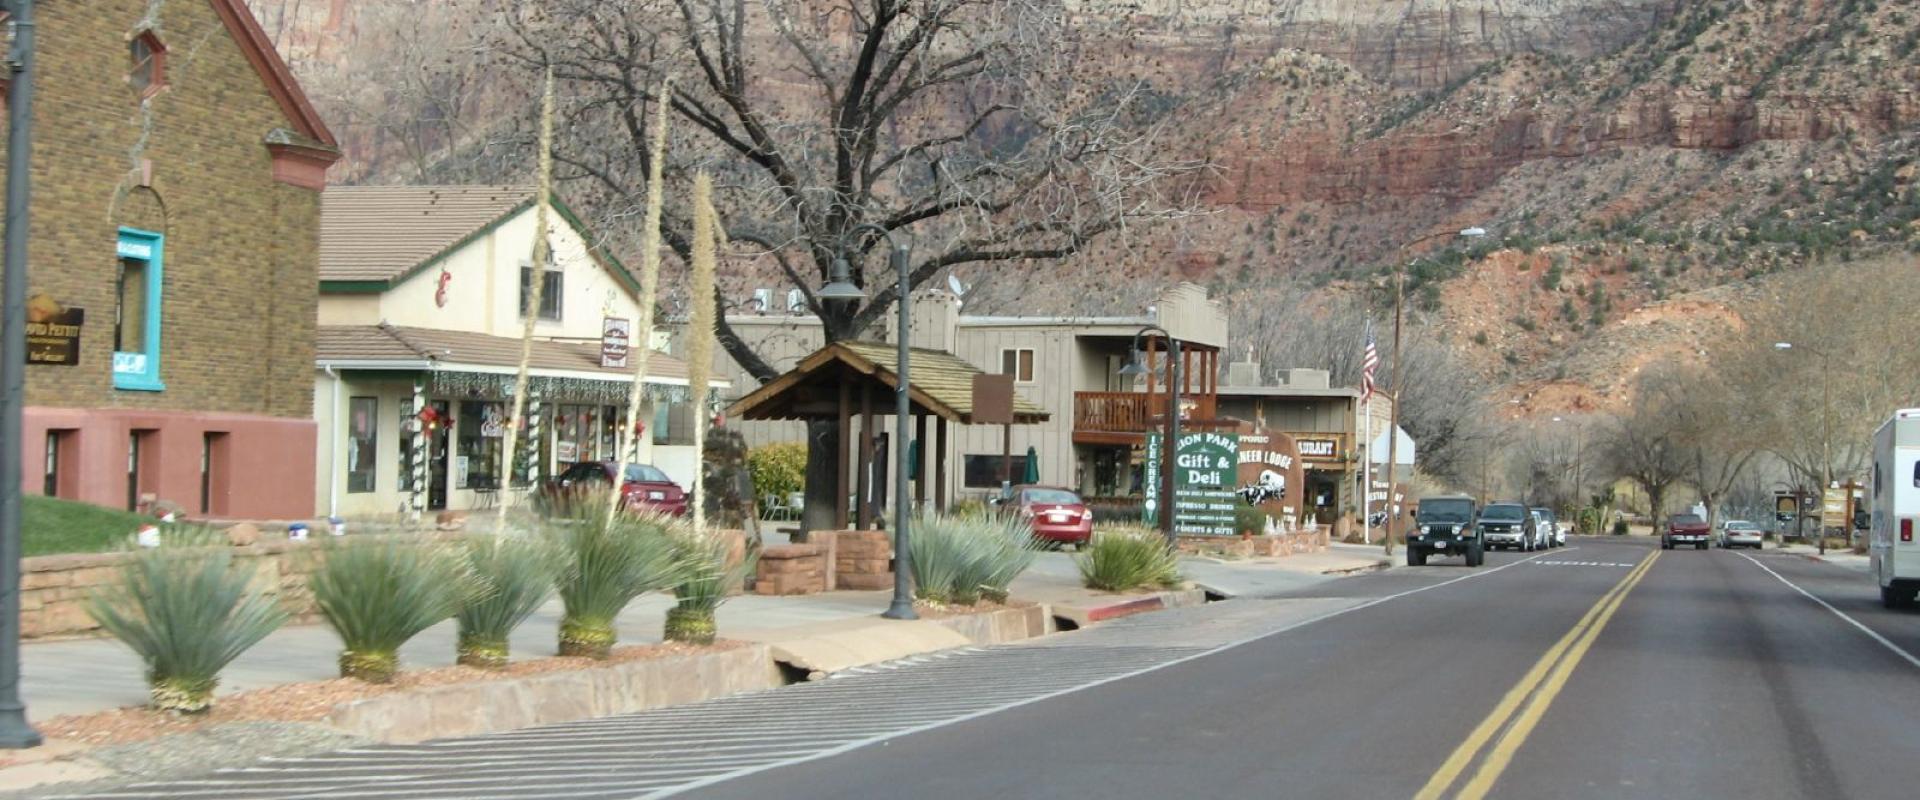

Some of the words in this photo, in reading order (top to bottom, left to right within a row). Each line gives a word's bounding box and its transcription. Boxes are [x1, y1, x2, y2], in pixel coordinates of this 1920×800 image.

[1149, 435, 1158, 459] ICE
[1206, 433, 1238, 453] PARK
[1177, 454, 1211, 468] Gift
[1217, 457, 1230, 469] &
[1237, 450, 1262, 464] NEER
[1264, 451, 1293, 470] LODGE
[1146, 460, 1157, 499] CREAM
[1188, 470, 1221, 485] Deli
